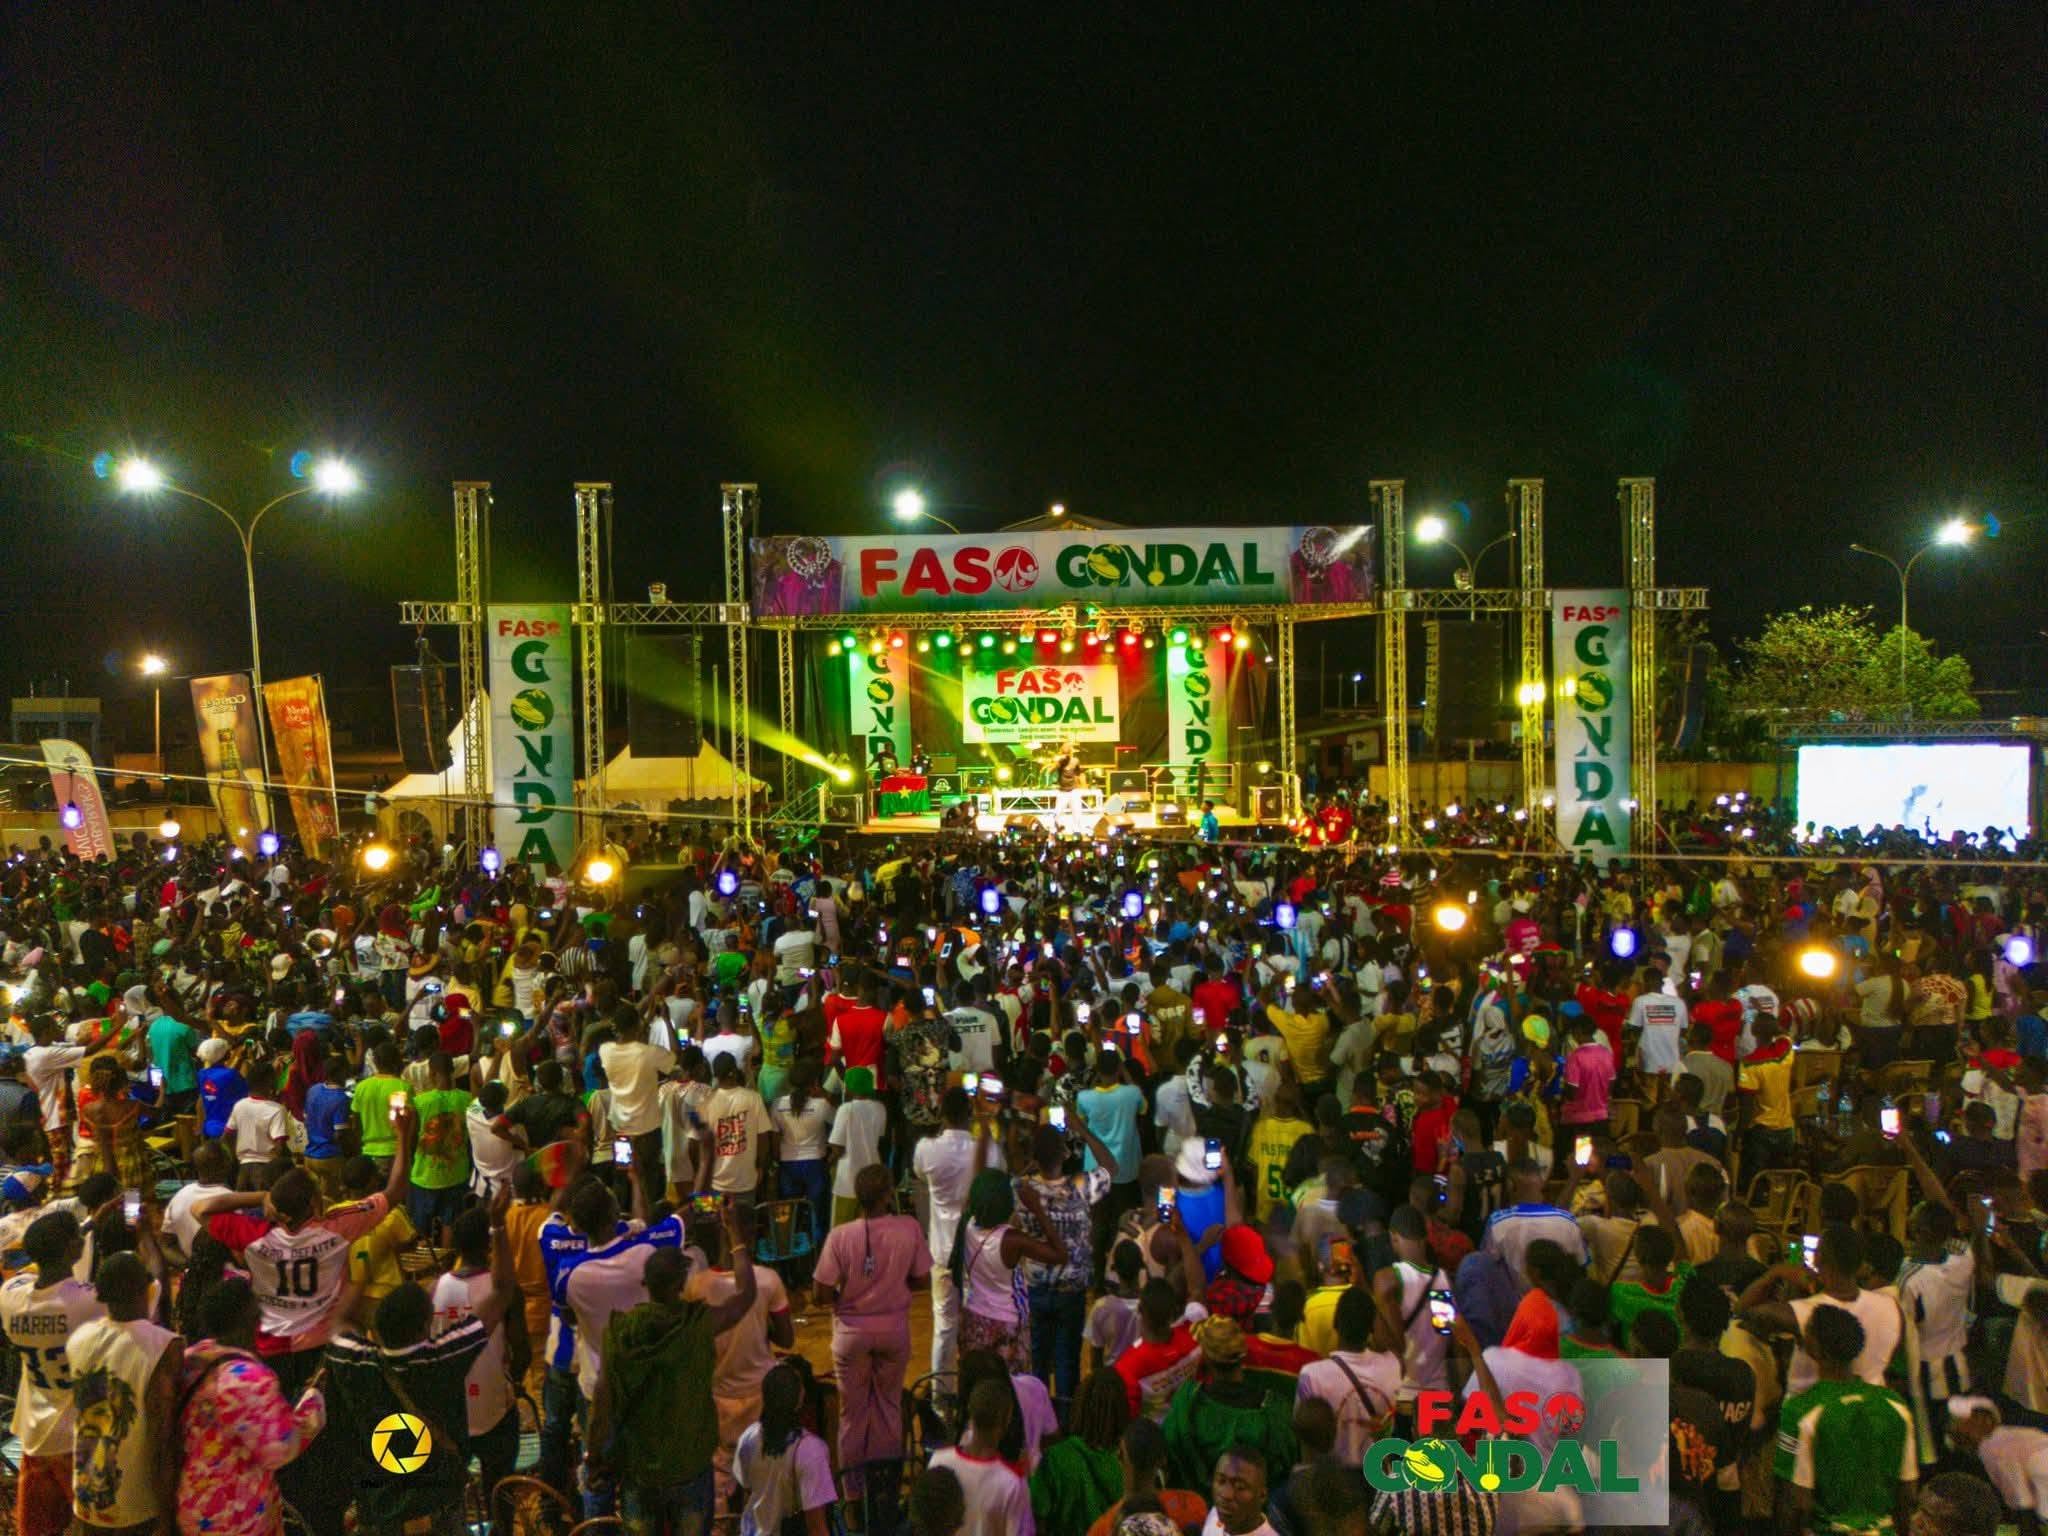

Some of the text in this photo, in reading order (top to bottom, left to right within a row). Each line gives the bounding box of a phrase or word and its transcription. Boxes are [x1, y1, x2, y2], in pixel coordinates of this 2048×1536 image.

[860, 542, 1275, 596] FASO GONDAL
[970, 696, 1115, 724] GONDAL
[276, 1258, 319, 1297] 10
[10, 1313, 68, 1335] HARRIS
